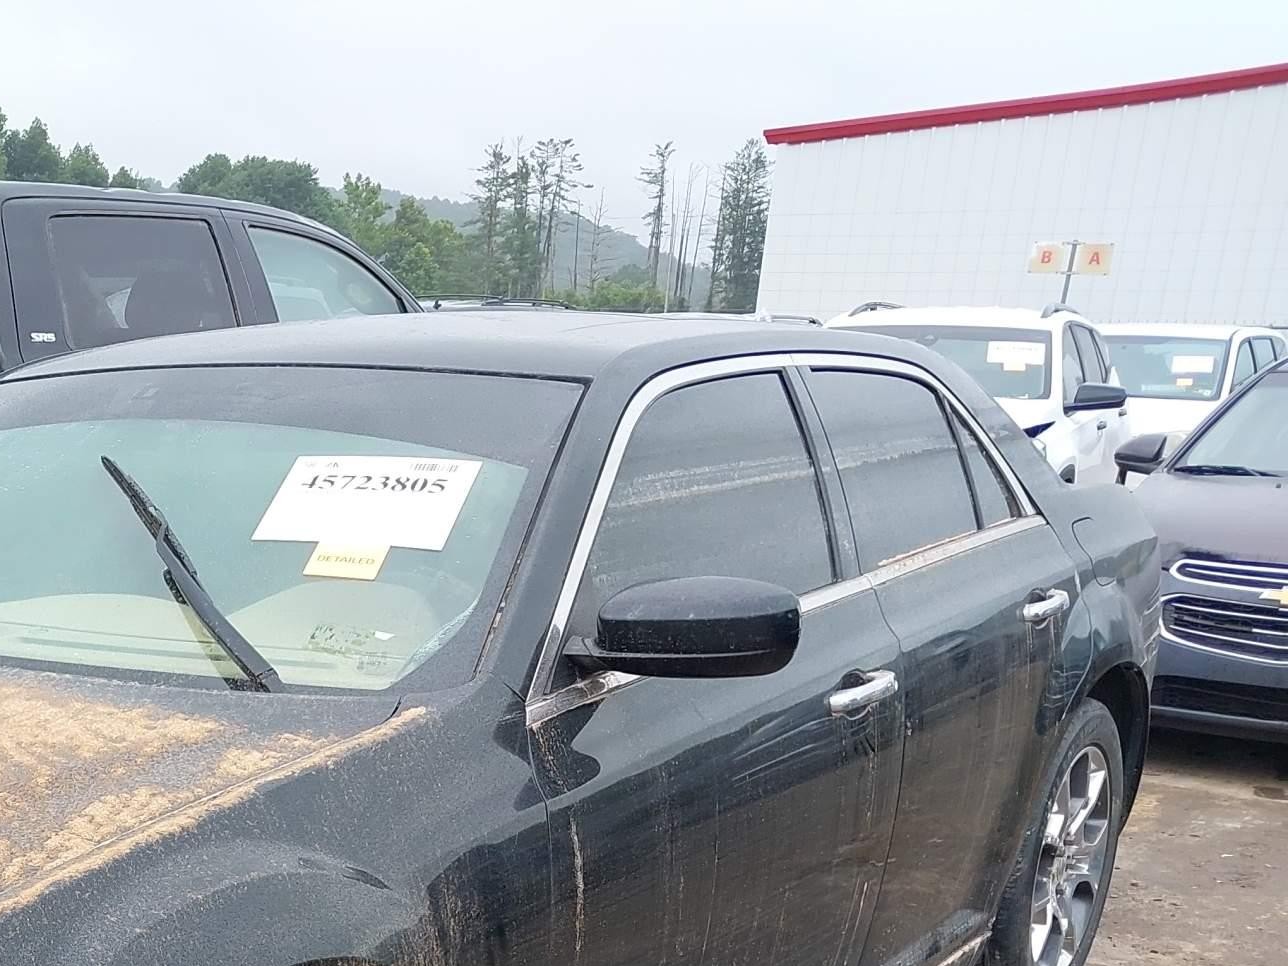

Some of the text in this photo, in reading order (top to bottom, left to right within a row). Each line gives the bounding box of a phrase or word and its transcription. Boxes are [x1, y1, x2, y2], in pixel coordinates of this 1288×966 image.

[1040, 250, 1052, 264] B
[1088, 251, 1100, 265] A
[301, 475, 448, 494] 45723805
[316, 554, 376, 566] DETAILED
